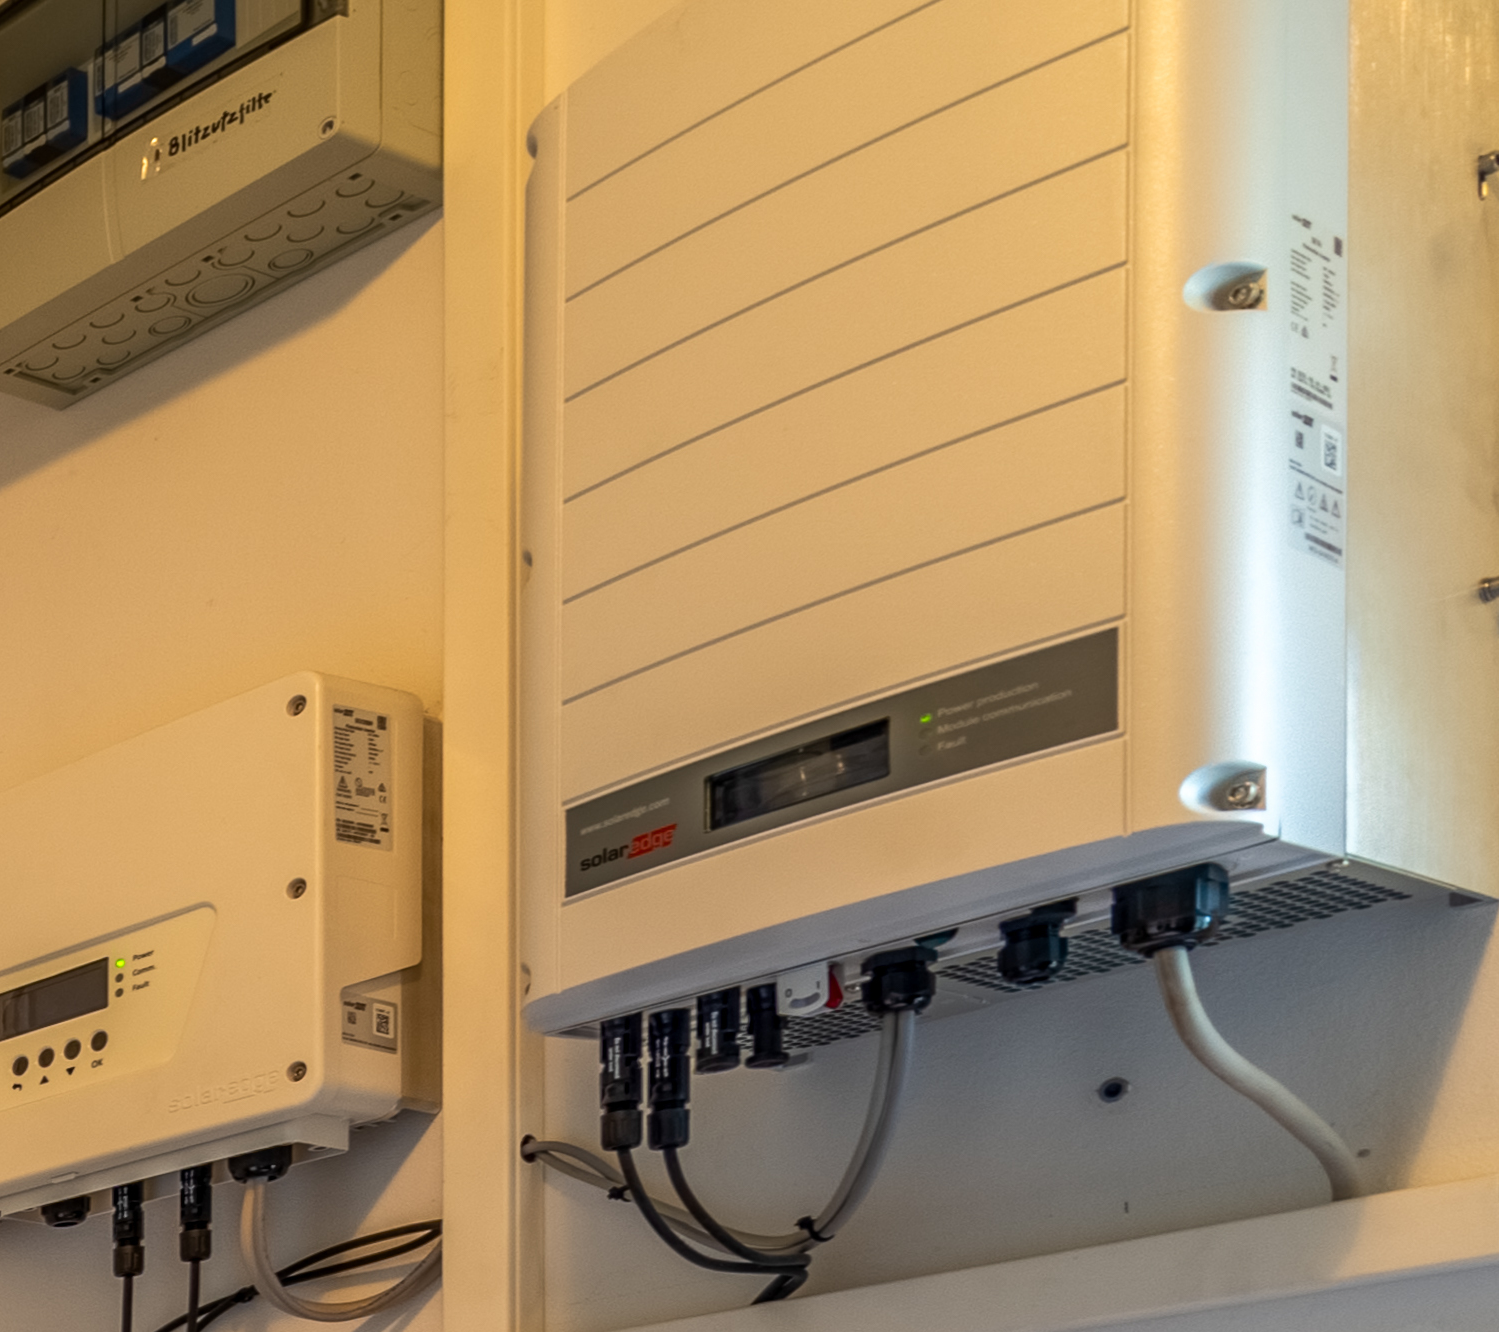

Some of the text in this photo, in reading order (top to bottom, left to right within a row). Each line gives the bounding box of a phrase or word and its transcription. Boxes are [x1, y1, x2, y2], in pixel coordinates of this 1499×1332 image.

[580, 823, 677, 872] solaredge
[132, 950, 155, 962] Power
[131, 980, 151, 992] Fault
[91, 1058, 104, 1070] OK
